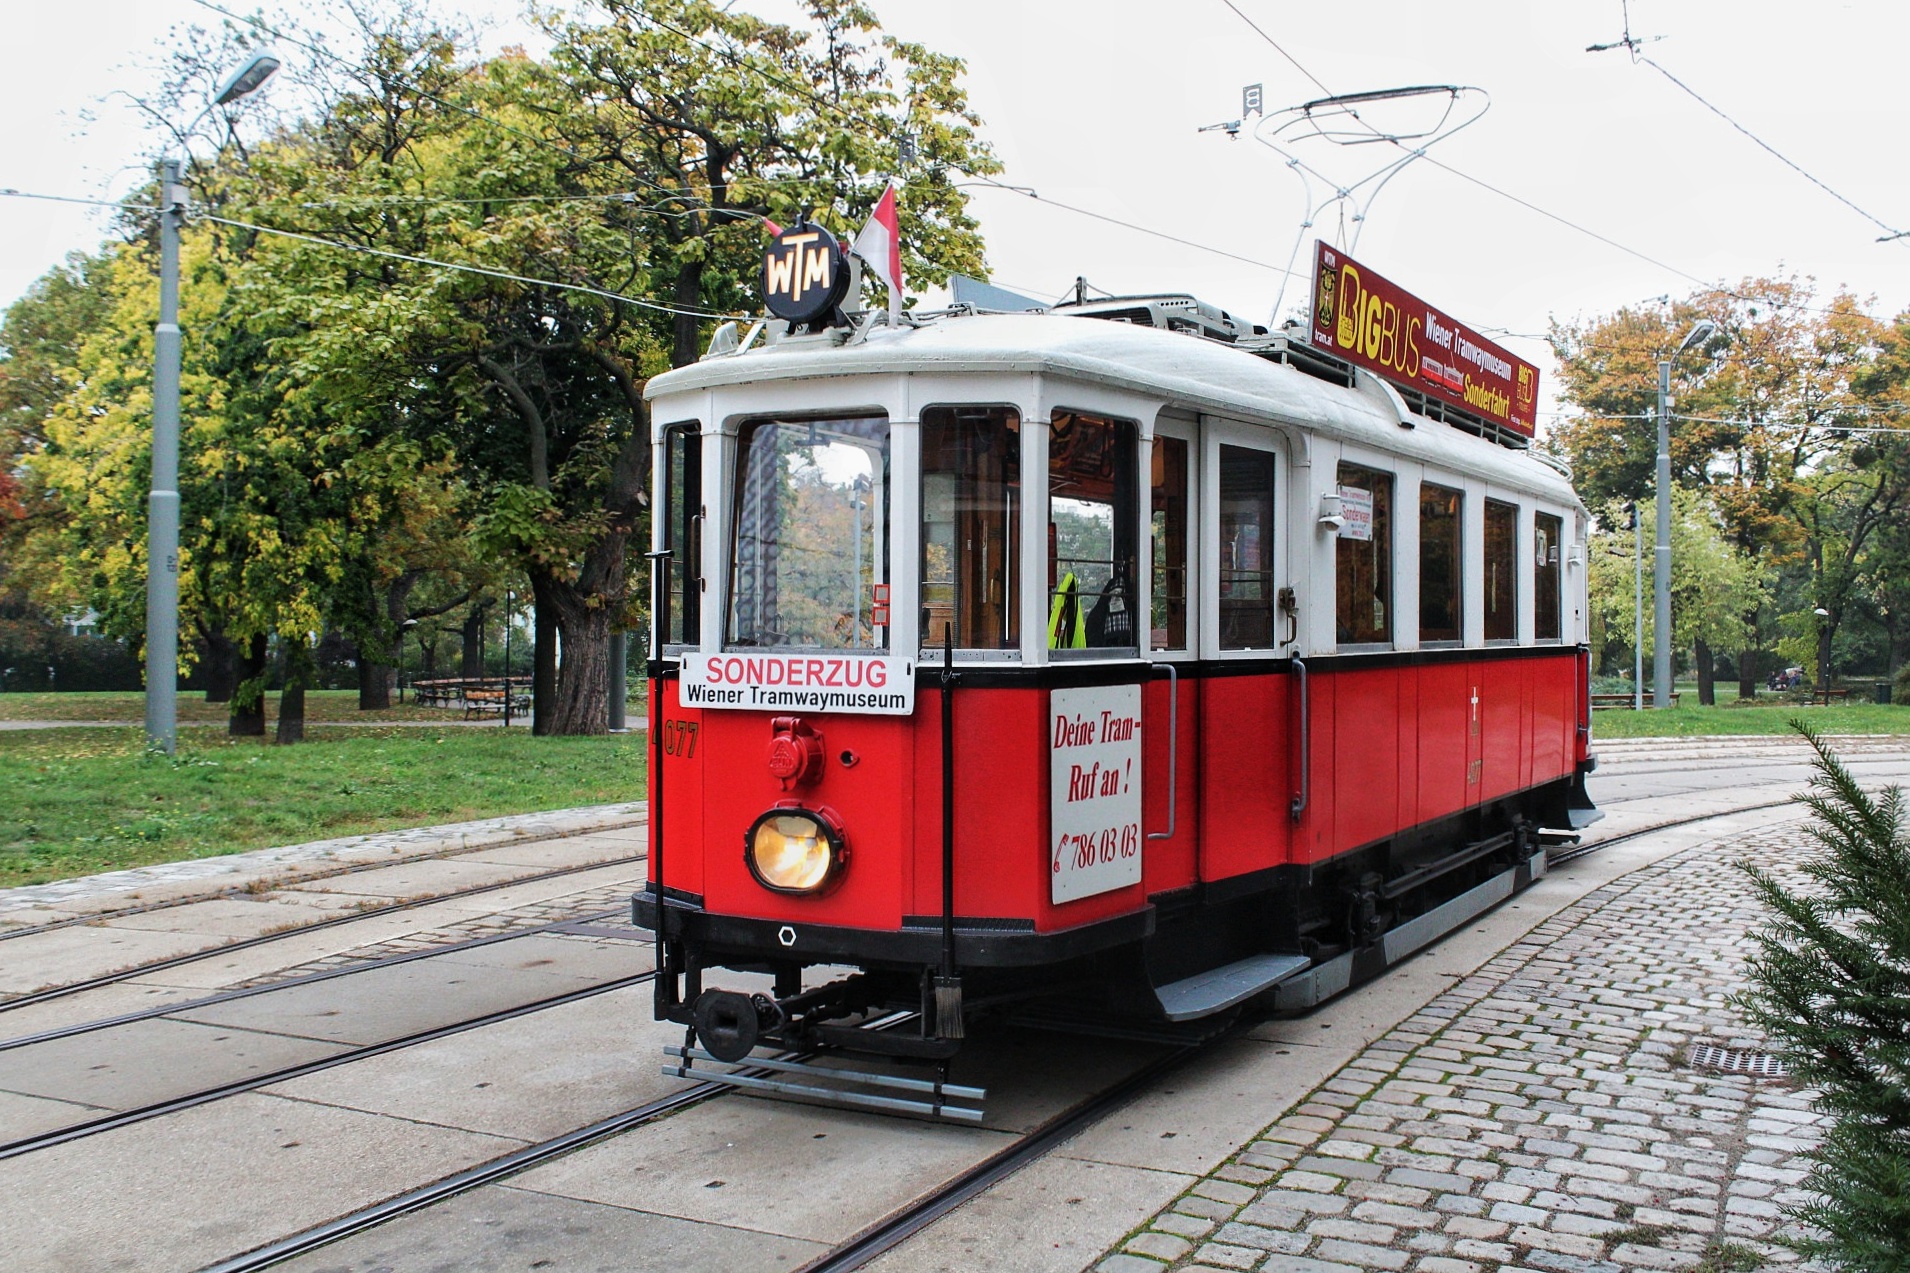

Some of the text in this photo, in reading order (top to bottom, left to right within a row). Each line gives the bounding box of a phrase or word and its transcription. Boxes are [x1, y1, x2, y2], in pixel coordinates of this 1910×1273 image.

[766, 232, 830, 302] WTM
[1314, 327, 1333, 347] tram.at
[1425, 311, 1512, 381] Wiener Tramwaymuseum
[1463, 373, 1510, 419] Sonderfahrt
[706, 657, 887, 688] SONDERZUG
[687, 684, 905, 711] Wiener Tramwaymuseum
[1054, 710, 1141, 749] Deine Tram-
[1068, 761, 1099, 803] Ruf
[1100, 768, 1119, 797] an
[1071, 823, 1138, 871] 786 03 03
